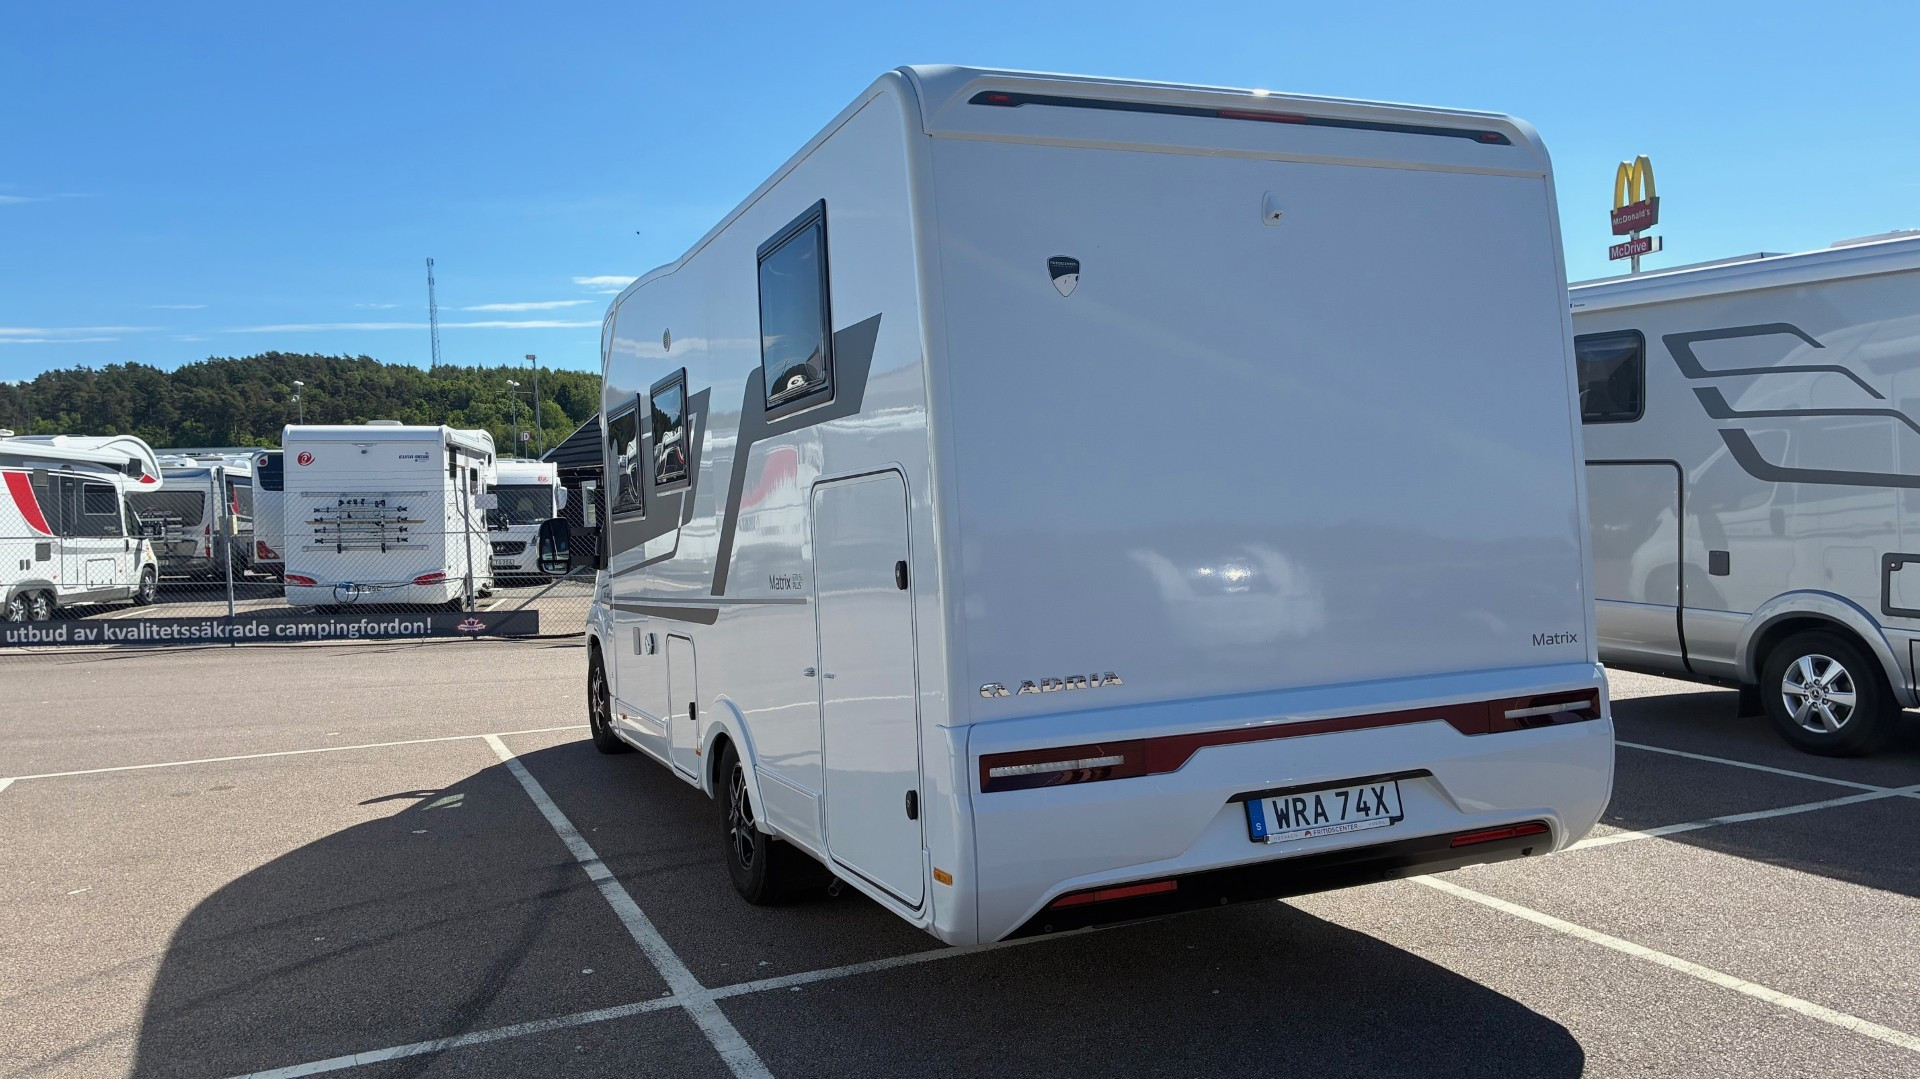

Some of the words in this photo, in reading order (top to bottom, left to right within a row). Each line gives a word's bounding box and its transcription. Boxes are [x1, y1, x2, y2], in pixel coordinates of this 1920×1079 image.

[1612, 208, 1651, 226] McDonald's
[1610, 240, 1647, 259] McDrive
[768, 573, 792, 590] Matrix
[5, 624, 67, 643] utbud
[73, 627, 98, 641] av
[103, 619, 270, 641] kvalitetssäkrade
[275, 617, 432, 639] campingfordon!
[1532, 631, 1578, 647] Matrix
[1015, 671, 1125, 696] ADRIA
[1271, 794, 1330, 830] WRA
[1334, 785, 1390, 821] 74X
[1255, 822, 1262, 831] S
[1313, 823, 1359, 837] FRITIDSCENTER
